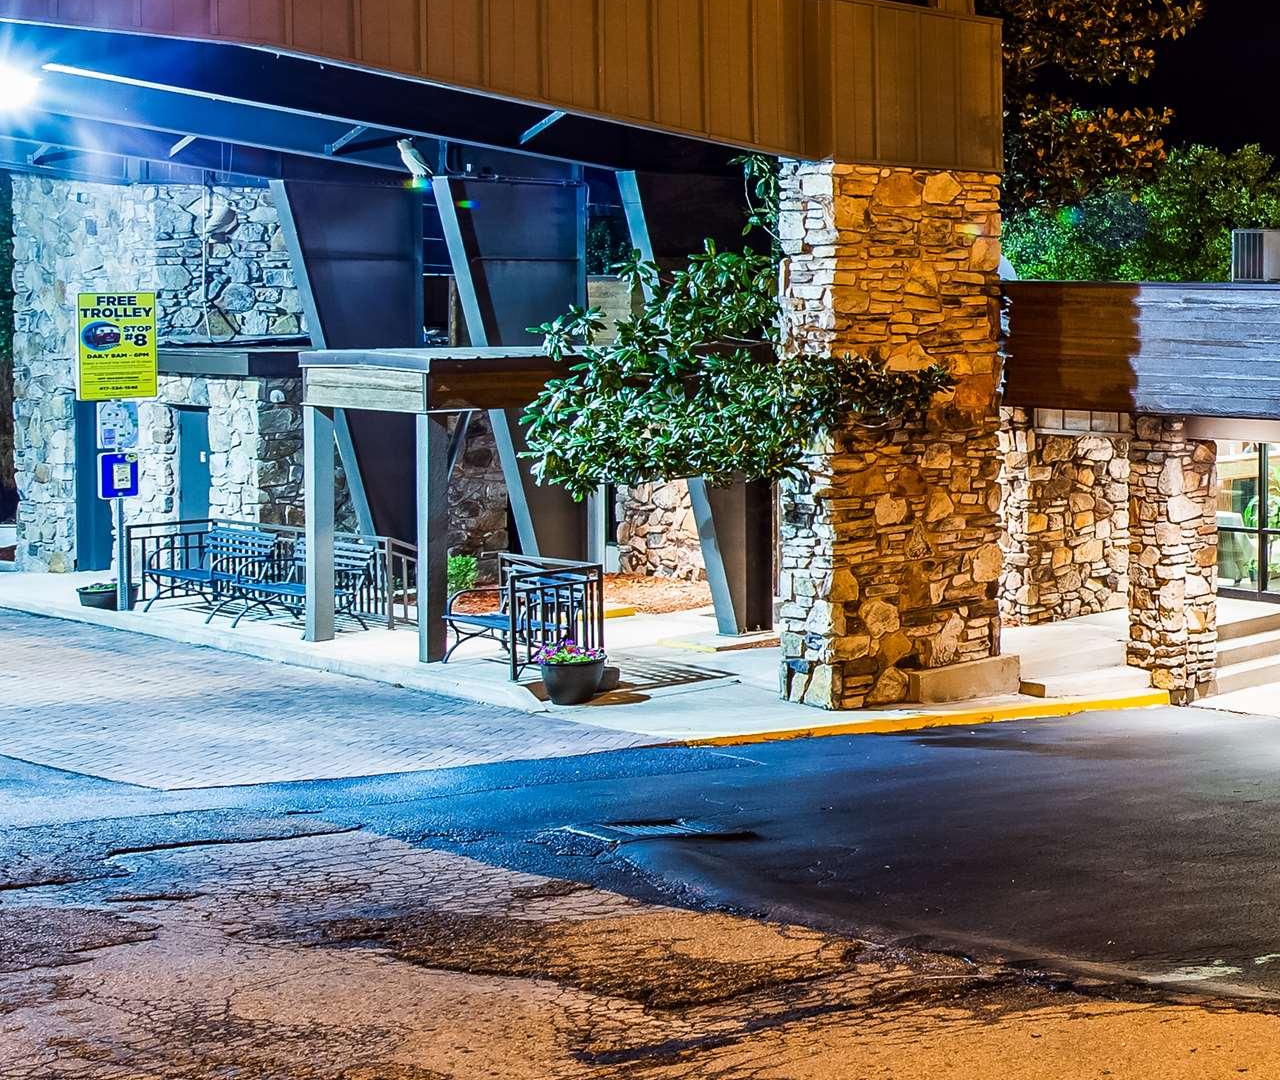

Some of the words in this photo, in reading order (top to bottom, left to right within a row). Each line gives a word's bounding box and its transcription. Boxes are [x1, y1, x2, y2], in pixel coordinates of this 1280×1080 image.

[96, 296, 137, 306] FREE
[80, 307, 153, 318] TROLLEY
[123, 325, 152, 333] STOP
